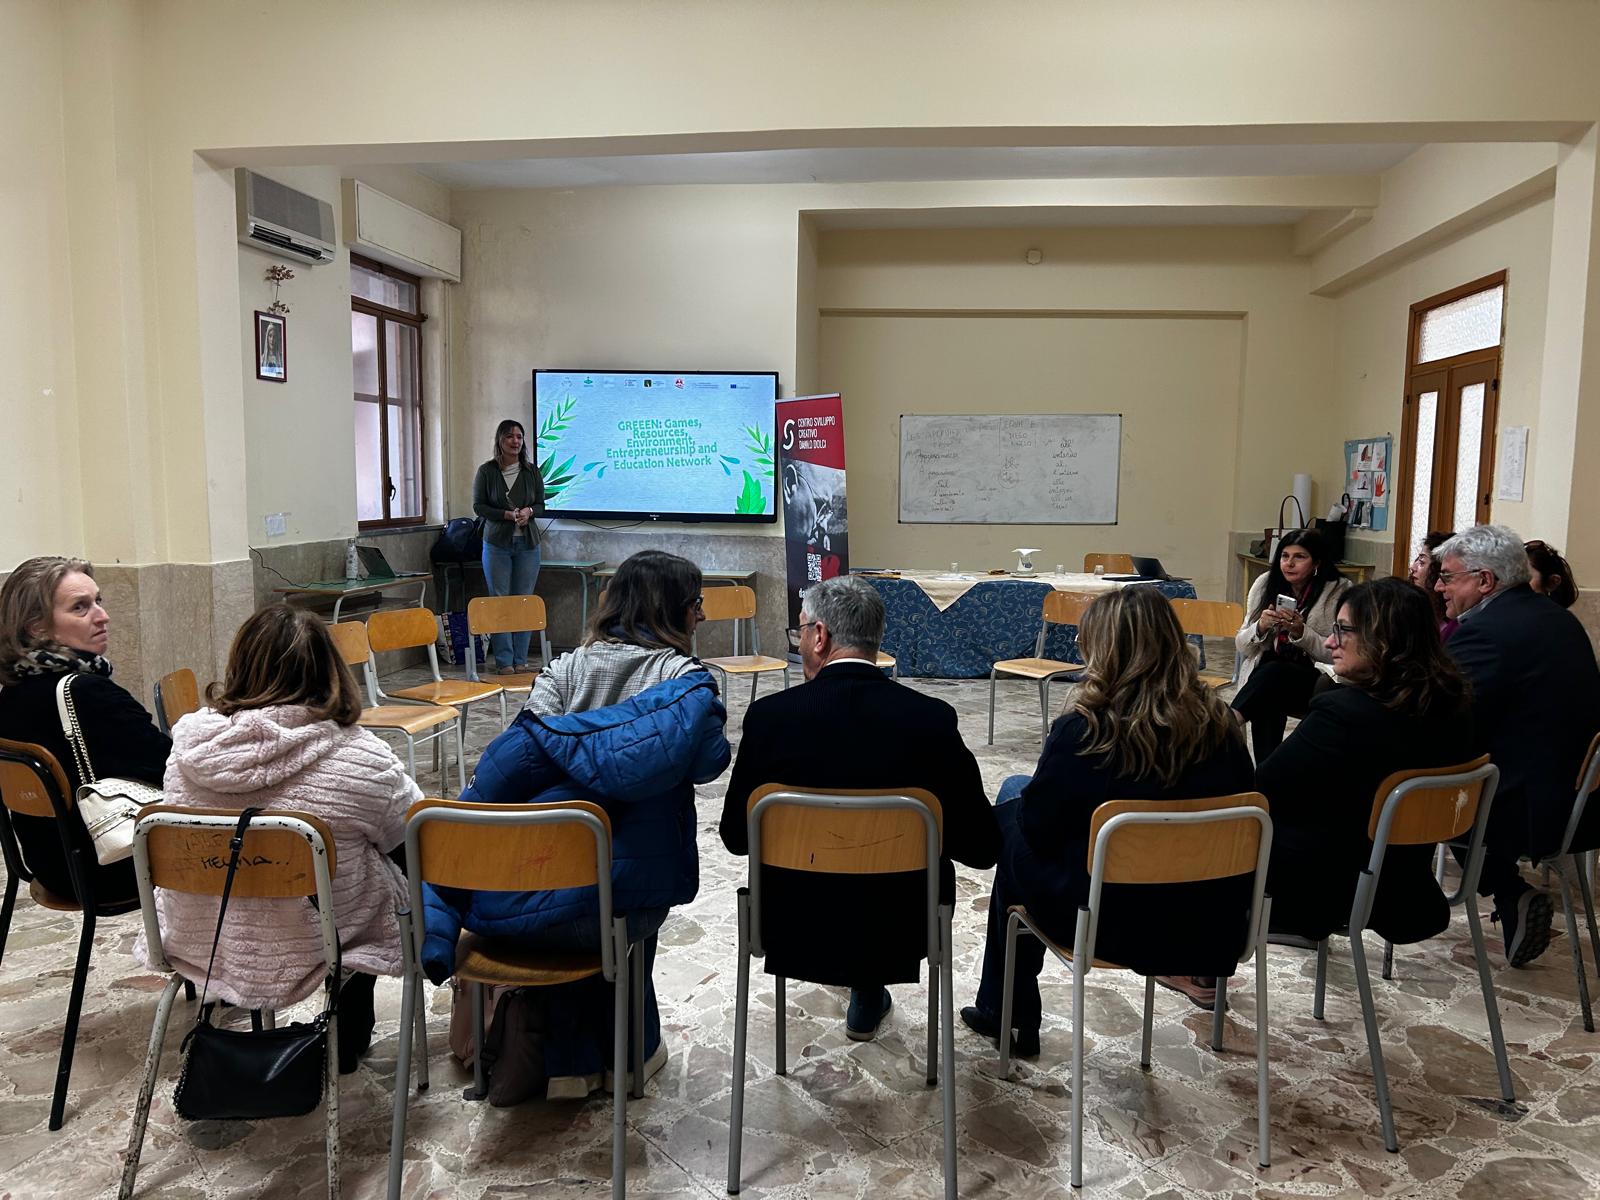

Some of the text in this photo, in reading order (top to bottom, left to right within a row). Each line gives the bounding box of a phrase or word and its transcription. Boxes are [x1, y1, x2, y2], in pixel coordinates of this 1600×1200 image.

[618, 418, 702, 431] GREEEN: Games,
[814, 416, 835, 427] SVILUPPO
[633, 428, 688, 439] Resources,
[799, 429, 817, 438] CREATIVO
[627, 435, 696, 448] Environment,
[813, 440, 827, 449] DOLCI
[606, 441, 717, 459] Entrepreneurship and
[614, 455, 712, 470] Education Network
